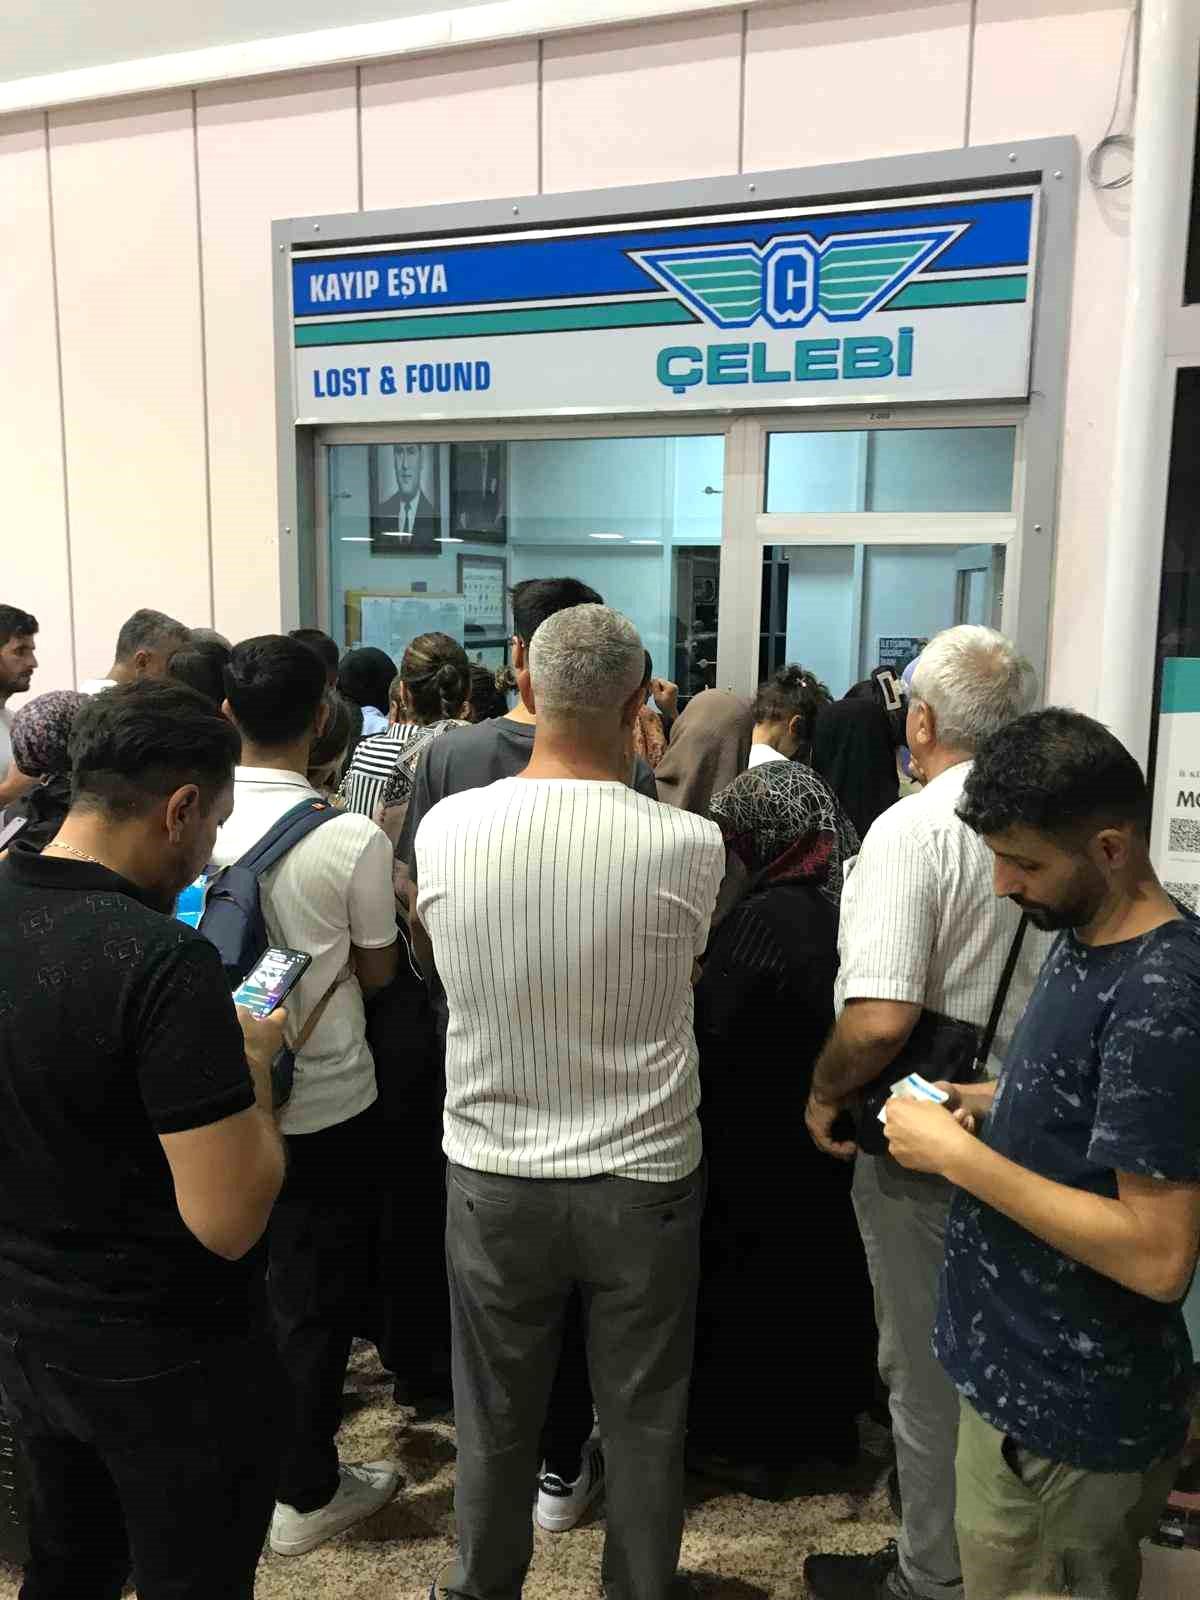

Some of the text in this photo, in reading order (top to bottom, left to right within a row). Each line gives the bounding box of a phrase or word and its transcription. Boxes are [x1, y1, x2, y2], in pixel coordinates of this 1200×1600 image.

[309, 270, 380, 303] KAYIP
[656, 326, 914, 394] ÇELEBİ
[313, 361, 491, 398] LOST & FOUND
